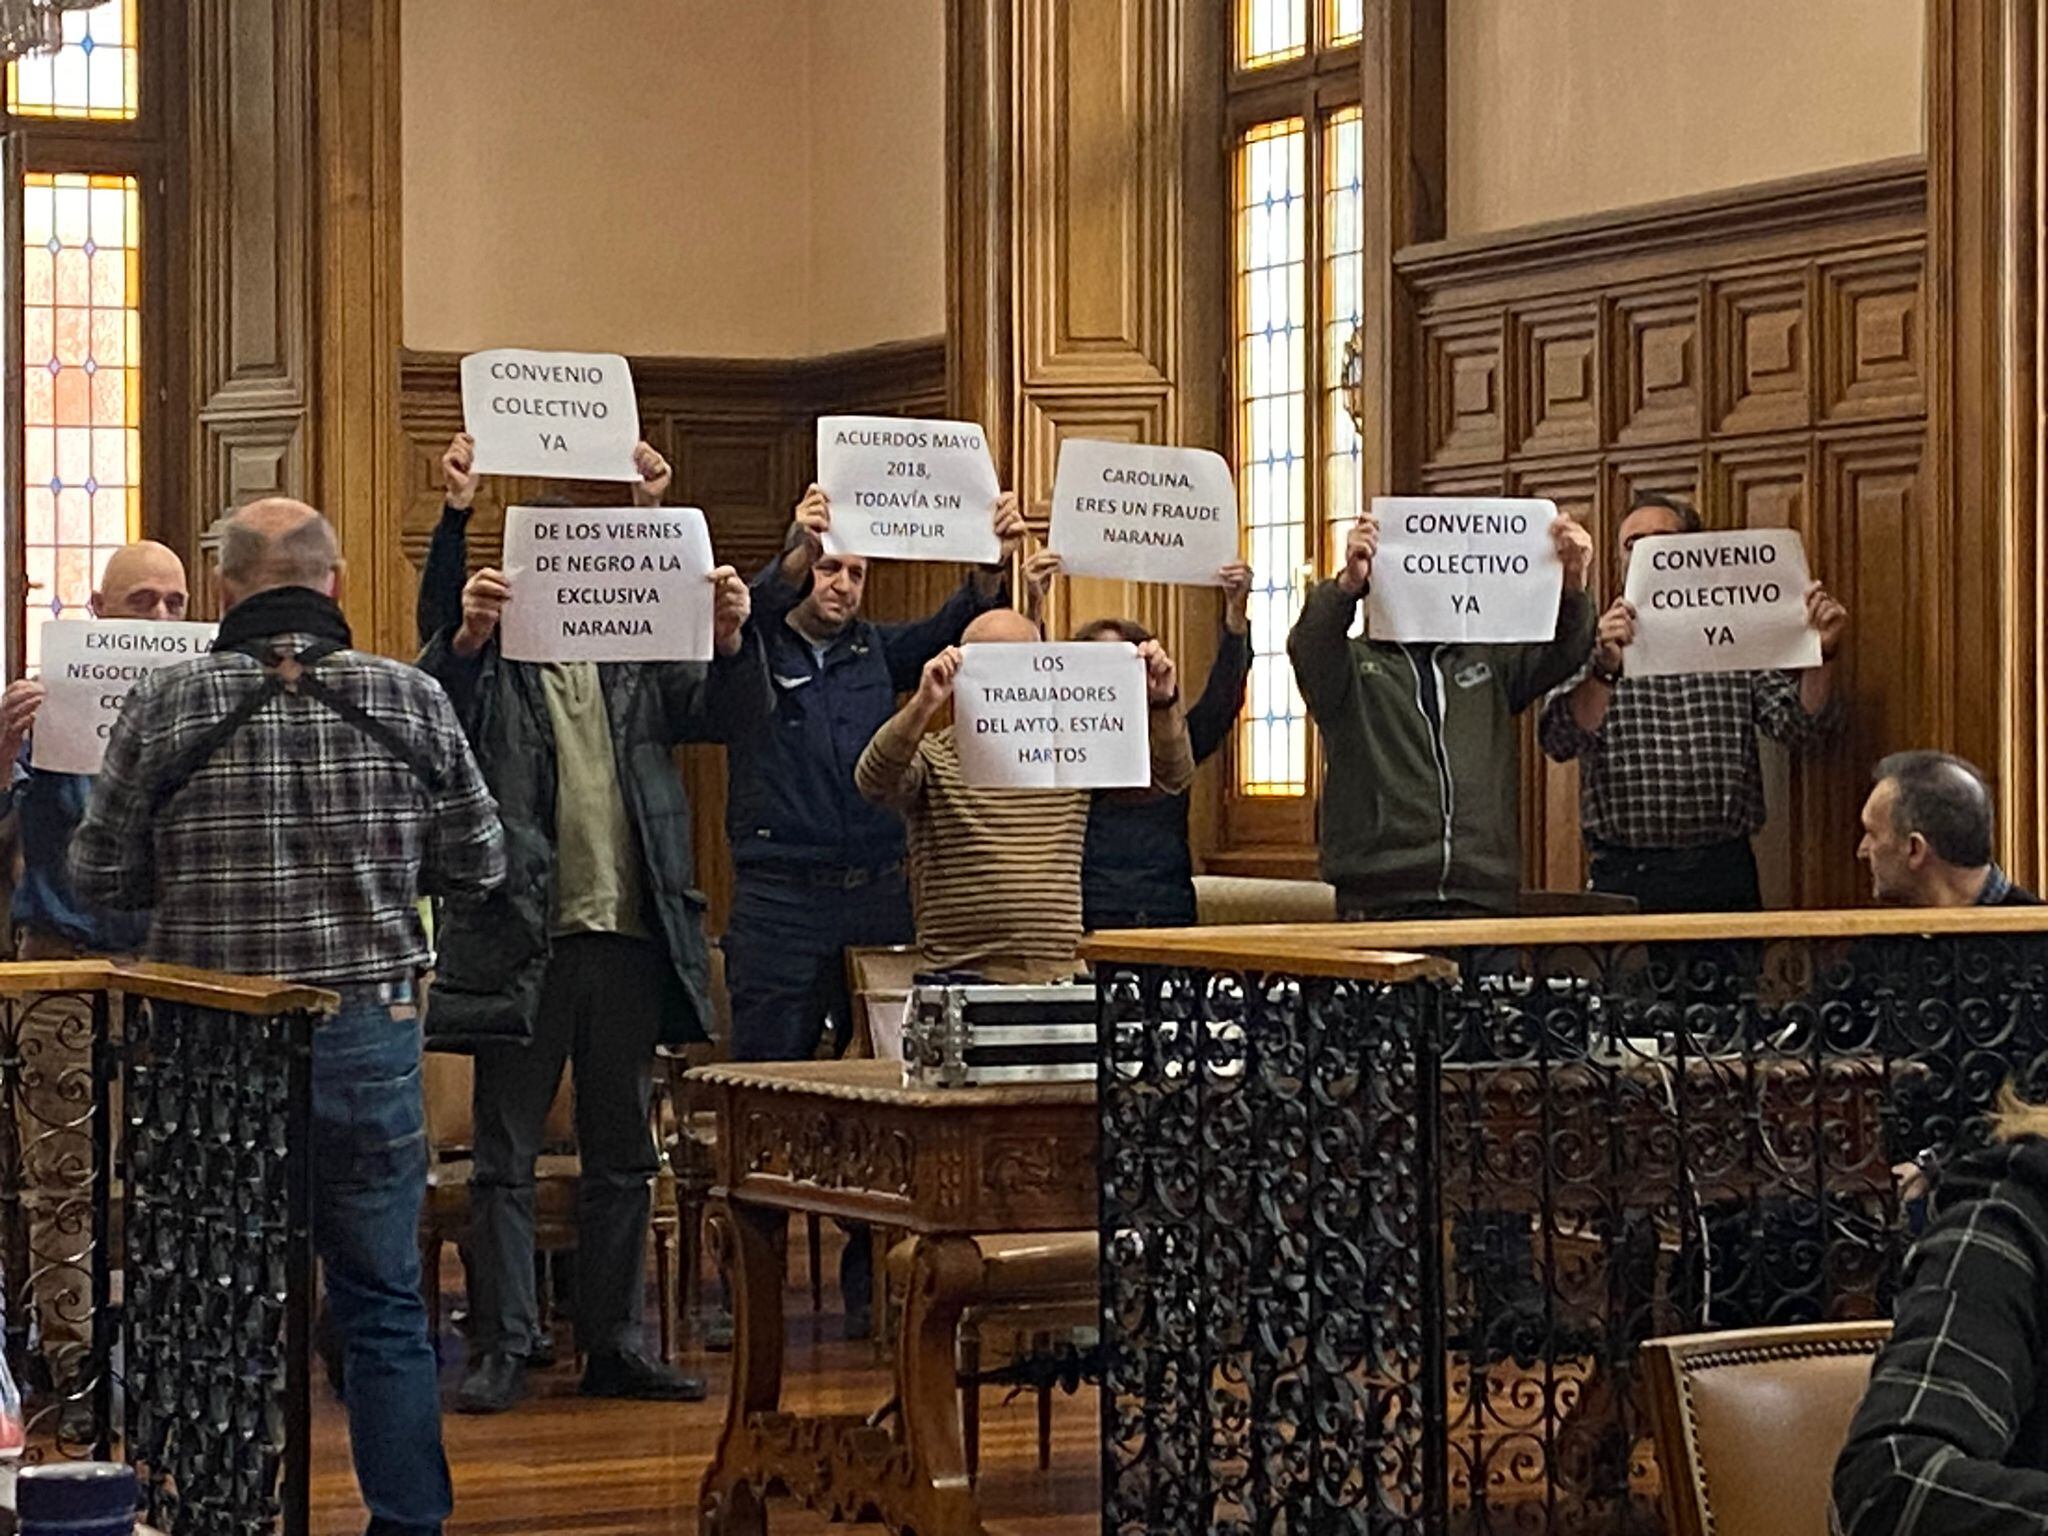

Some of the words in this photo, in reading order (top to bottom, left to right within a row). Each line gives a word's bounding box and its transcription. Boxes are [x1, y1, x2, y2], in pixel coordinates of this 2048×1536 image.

[491, 363, 602, 384] CONVENIO
[493, 397, 608, 419] COLECTIVO
[539, 434, 567, 451] YA
[836, 431, 927, 448] ACUERDOS
[933, 434, 980, 449] MAYO
[888, 462, 931, 479] 2018,
[1103, 469, 1194, 490] CAROLINA,
[855, 490, 928, 508] TODAVÍA
[934, 494, 961, 509] SIN
[1076, 497, 1116, 514] ERES
[1122, 501, 1147, 516] UN
[1153, 503, 1219, 521] FRAUDE
[535, 524, 558, 540] DE
[567, 524, 600, 540] LOS
[606, 523, 682, 540] VIERNES
[871, 522, 944, 537] CUMPLIR
[1406, 515, 1526, 533] CONVENIO
[1104, 529, 1184, 547] NARANJA
[537, 556, 560, 572] DE
[568, 555, 634, 572] NEGRO
[641, 556, 653, 571] A
[660, 555, 681, 571] LA
[1404, 555, 1528, 574] COLECTIVO
[1653, 545, 1775, 570] CONVENIO
[557, 588, 659, 604] EXCLUSIVA
[1452, 595, 1480, 614] YA
[1652, 583, 1780, 609] COLECTIVO
[563, 620, 652, 636] NARANJA
[1704, 626, 1734, 646] YA
[86, 633, 187, 654] EXIGIMOS
[1033, 656, 1063, 671] LOS
[983, 687, 1116, 702] TRABAJADORES
[977, 719, 1008, 734] DEL
[1014, 717, 1063, 733] AYTO.
[1071, 714, 1123, 732] ESTÁN
[1019, 748, 1086, 763] HARTOS
